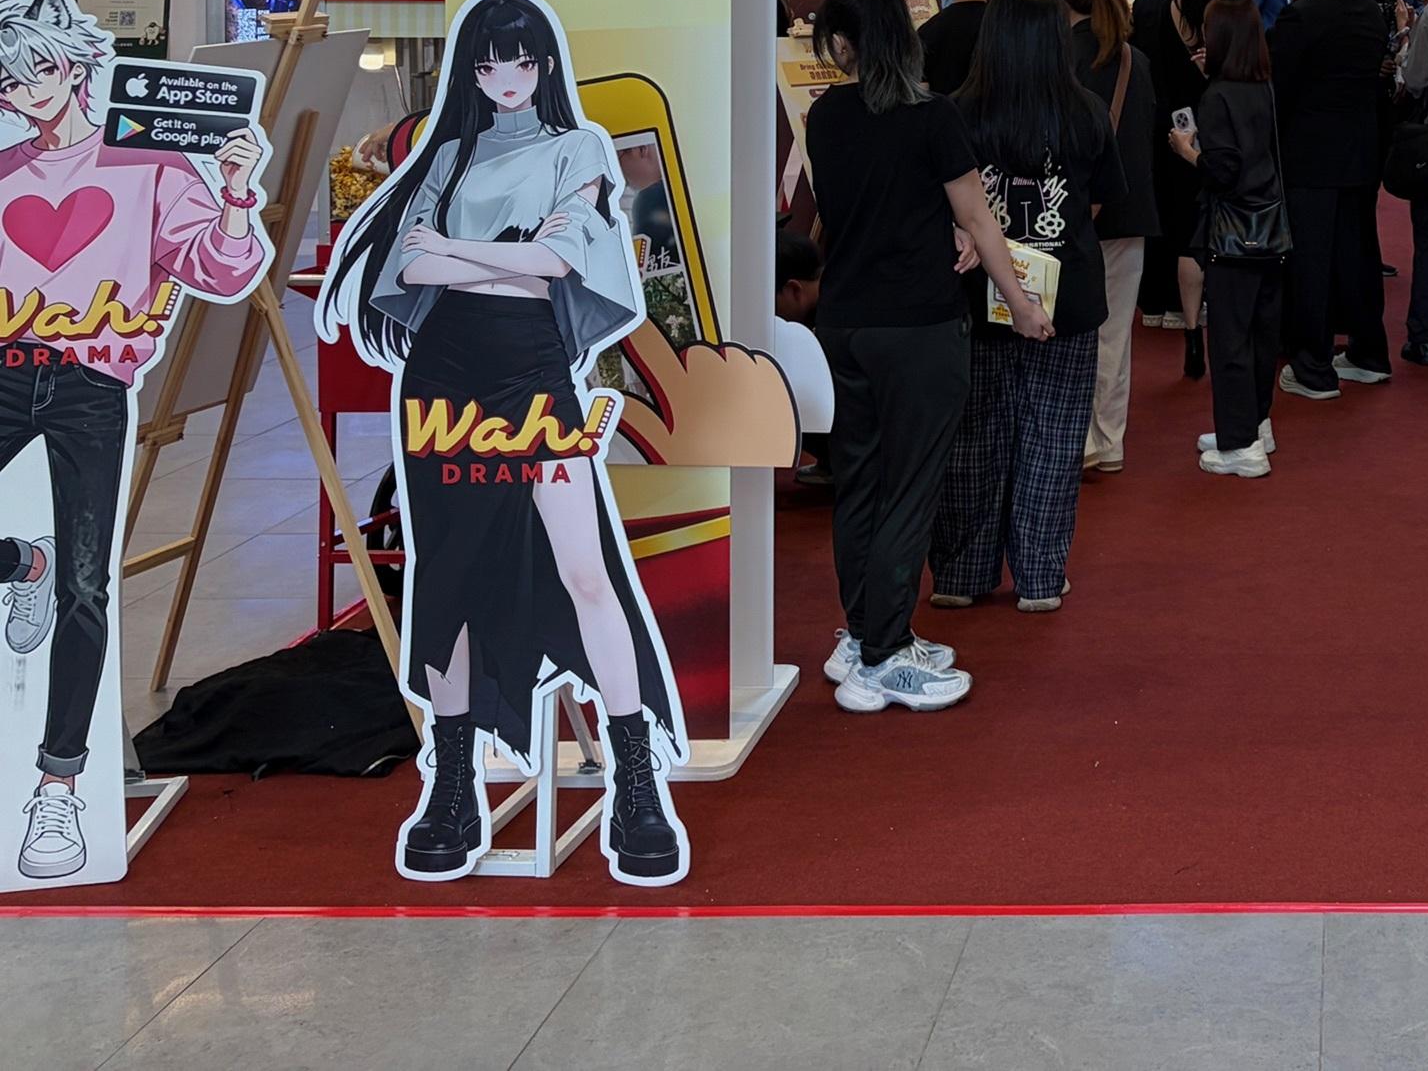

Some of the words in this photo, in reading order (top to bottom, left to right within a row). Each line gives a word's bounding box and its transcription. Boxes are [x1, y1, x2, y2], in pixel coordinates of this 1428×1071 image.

[159, 75, 206, 89] Available
[206, 81, 219, 90] on
[221, 80, 238, 92] the
[156, 86, 193, 105] App
[195, 88, 238, 105] Store
[153, 117, 172, 128] Get
[183, 120, 196, 130] on
[151, 128, 200, 146] Google
[201, 132, 228, 147] play
[6, 344, 139, 368] DRAMA
[404, 393, 617, 458] Wah!
[441, 462, 572, 485] DRAMA
